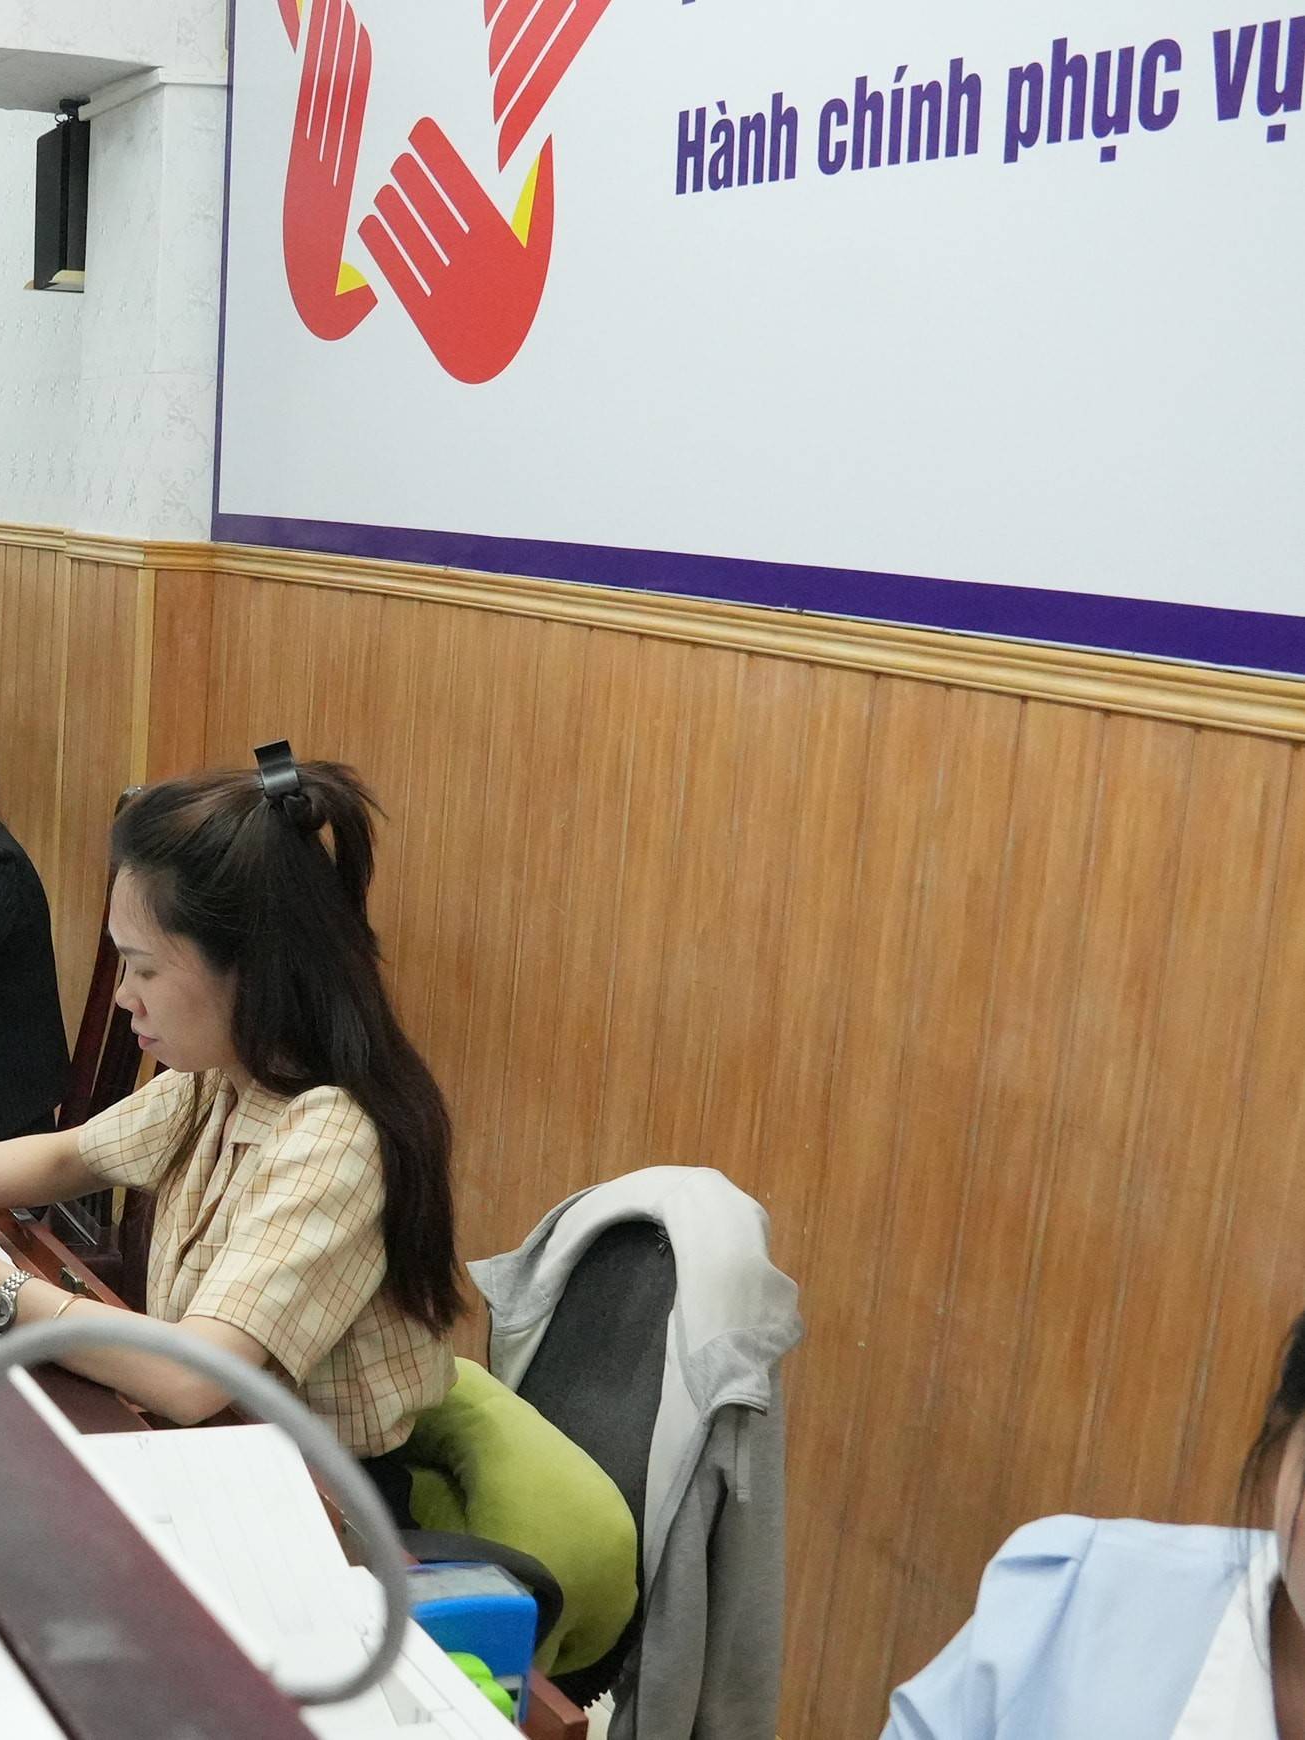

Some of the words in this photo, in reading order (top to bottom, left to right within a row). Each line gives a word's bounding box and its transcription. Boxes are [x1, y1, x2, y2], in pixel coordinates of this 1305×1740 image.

[676, 93, 799, 195] Hành
[817, 57, 982, 176] chính
[1003, 37, 1182, 164] phục
[1212, 15, 1305, 143] vụ
